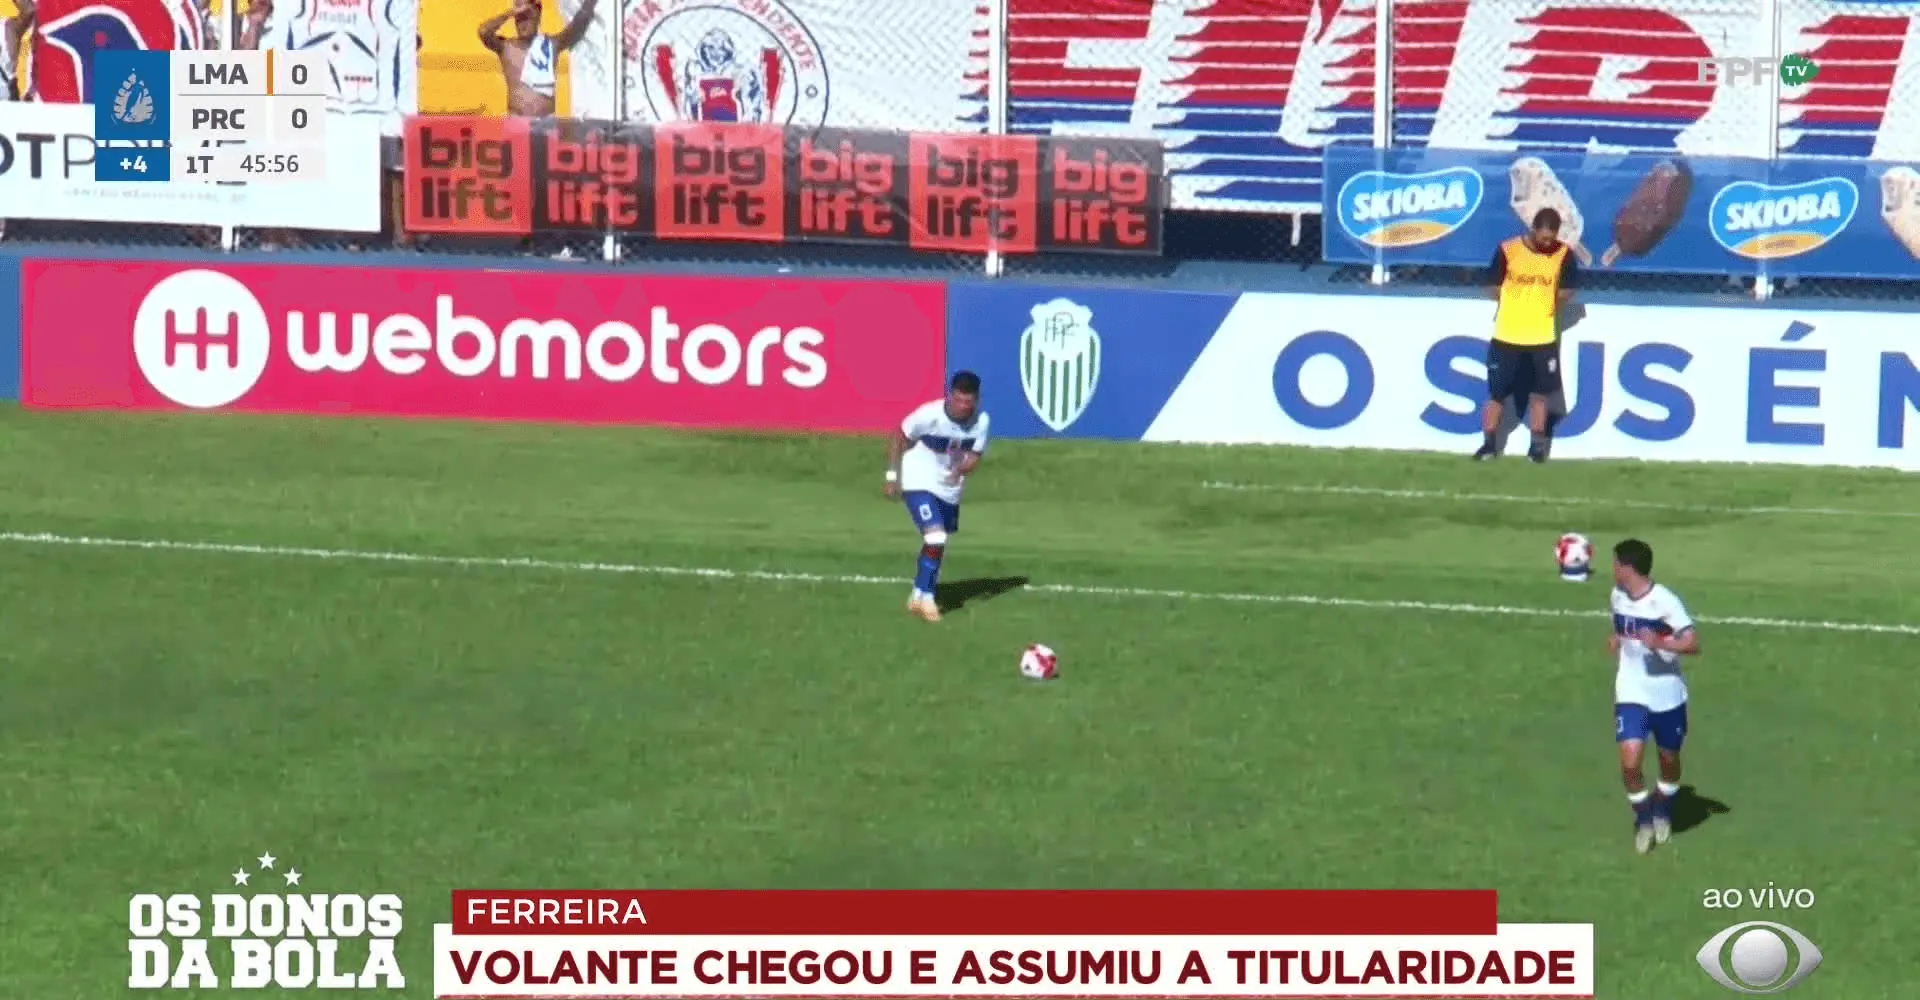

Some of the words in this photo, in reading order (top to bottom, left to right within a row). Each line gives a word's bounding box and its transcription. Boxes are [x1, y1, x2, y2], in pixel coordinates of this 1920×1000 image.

[419, 127, 514, 178] big
[546, 130, 640, 184] big
[672, 134, 767, 186] big
[798, 138, 894, 193] big
[926, 143, 1019, 193] big
[1053, 149, 1148, 201] big
[420, 176, 513, 220] lift
[547, 180, 640, 225] lift
[672, 183, 766, 226] lift
[799, 188, 893, 235] lift
[926, 195, 1018, 239] lift
[1053, 199, 1147, 244] lift
[1352, 179, 1466, 221] SKIOBA
[1725, 190, 1840, 231] SKIOBA
[286, 294, 828, 388] webmotors
[1272, 330, 1375, 429] O
[1746, 320, 1827, 446] É
